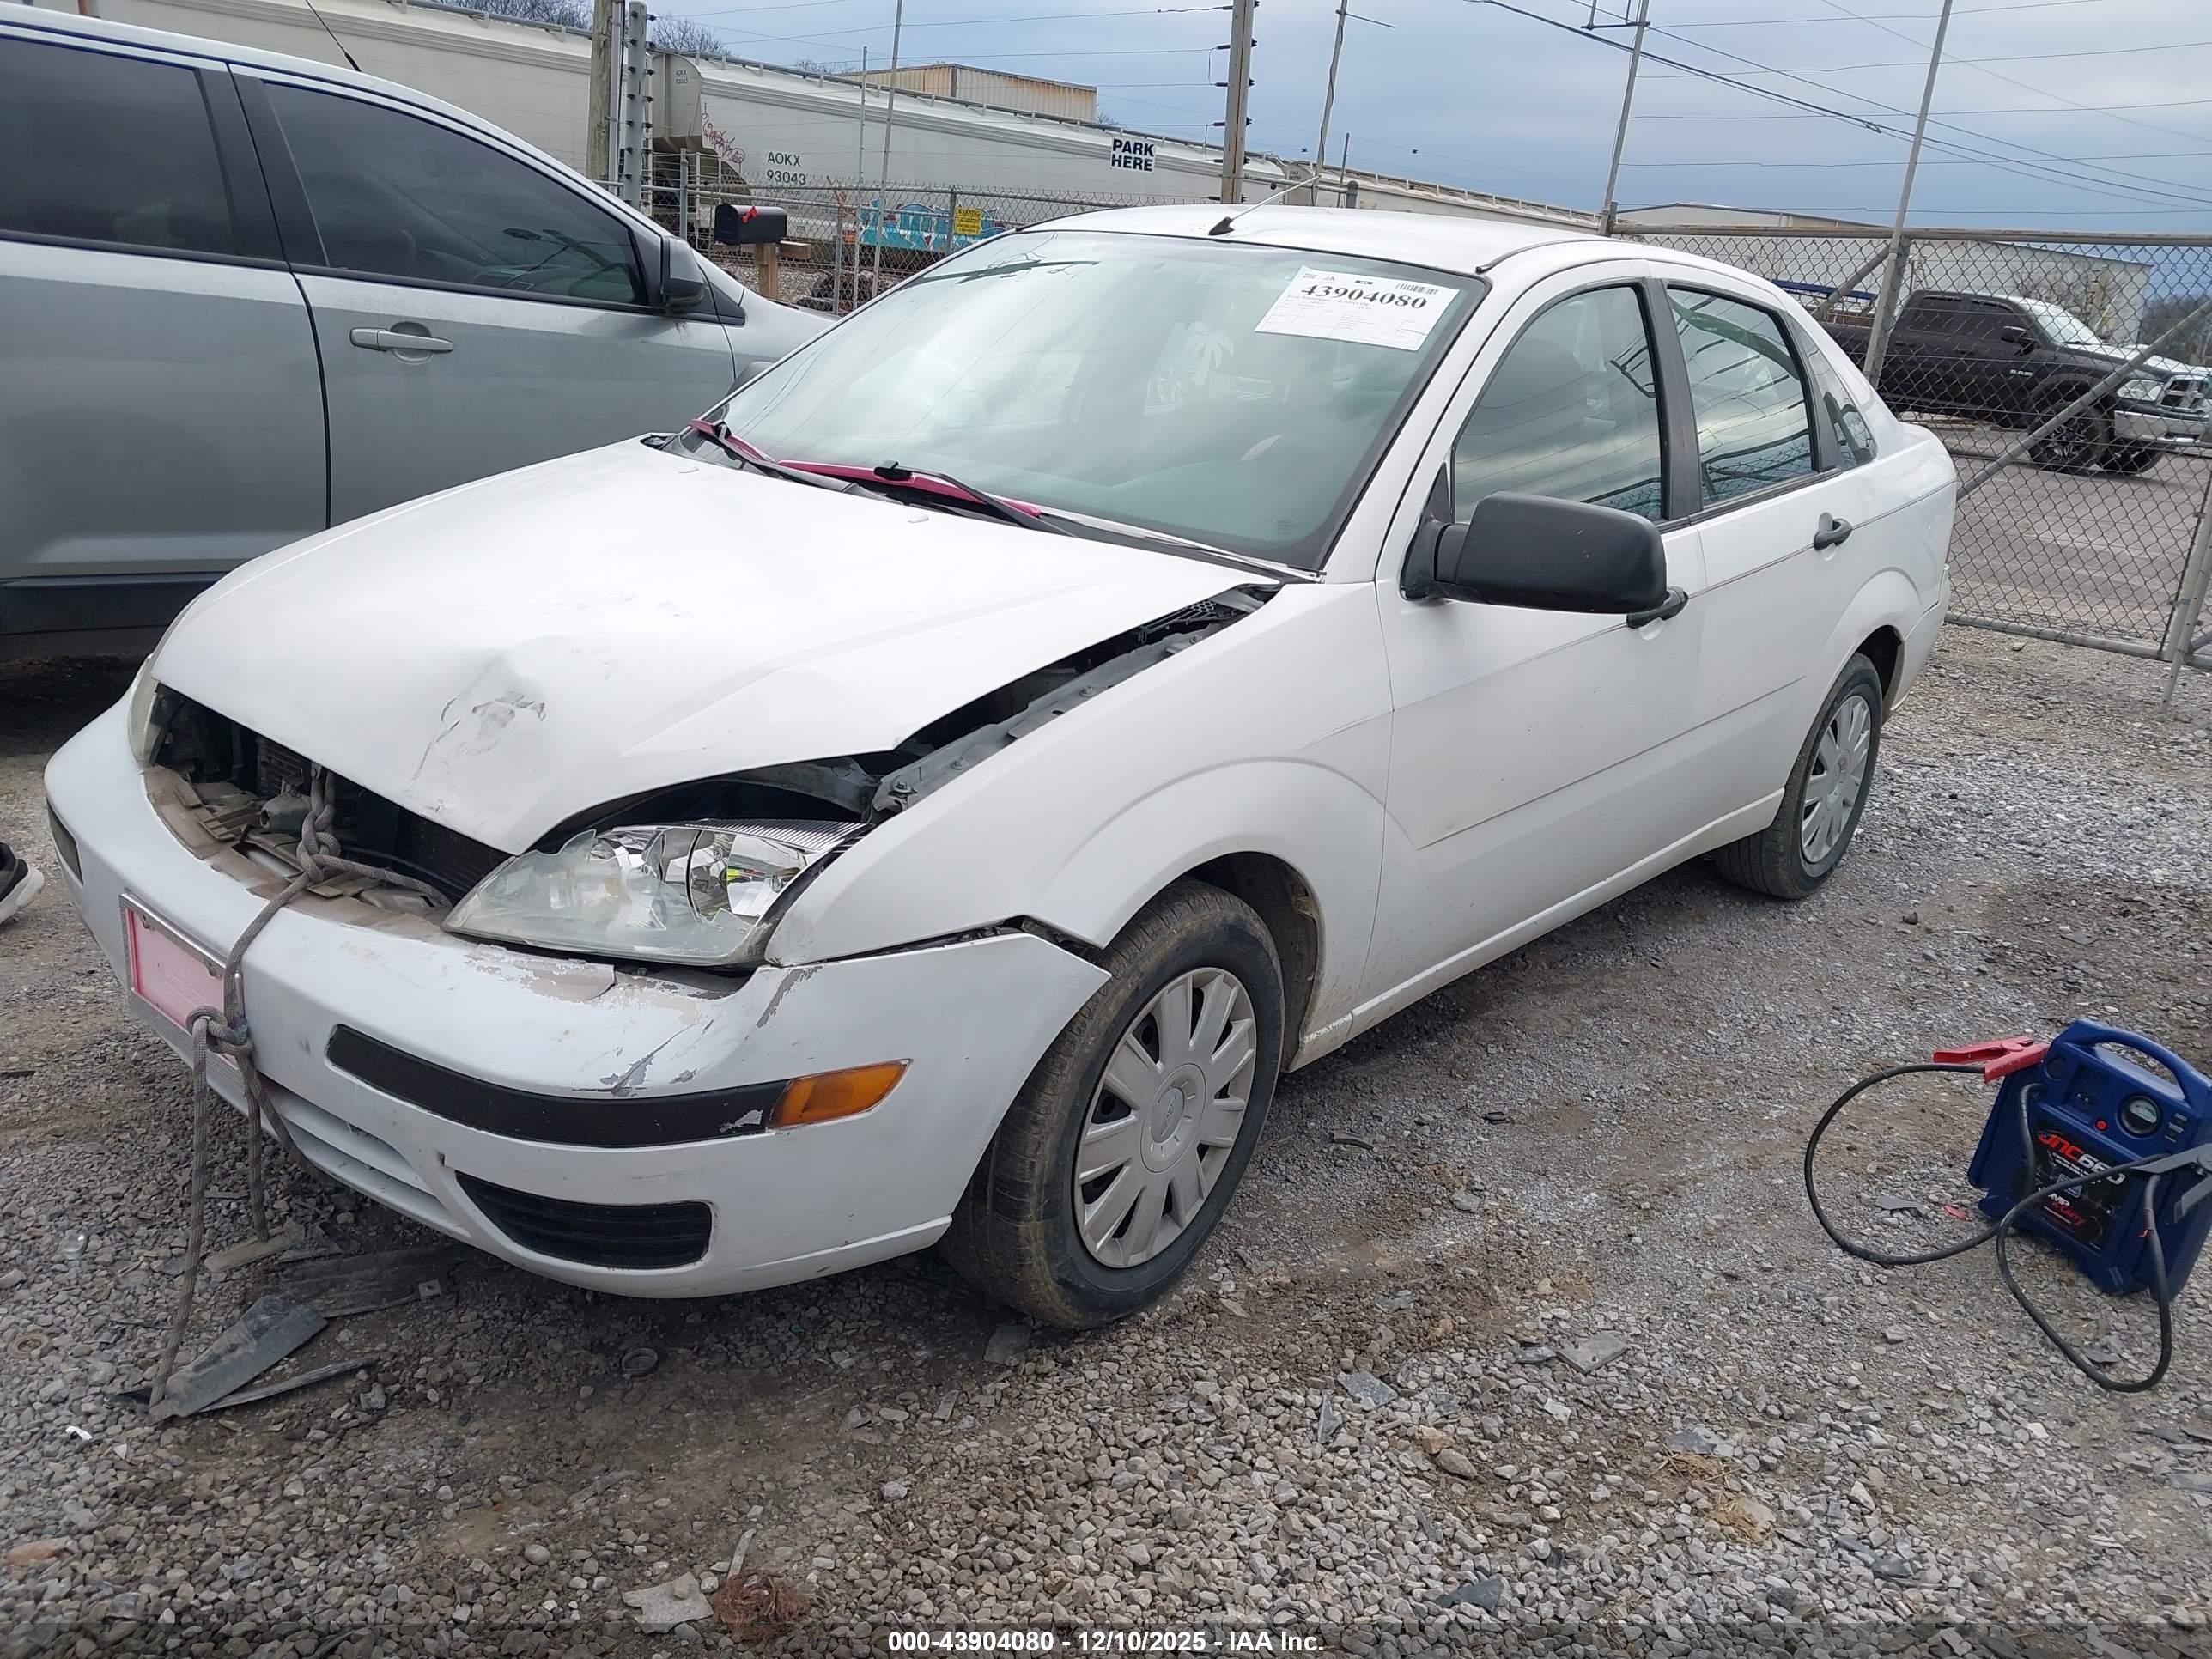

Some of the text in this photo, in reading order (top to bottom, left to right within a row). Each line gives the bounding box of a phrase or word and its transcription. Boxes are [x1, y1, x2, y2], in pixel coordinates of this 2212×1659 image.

[1113, 138, 1155, 157] PARK
[767, 151, 801, 167] AOKX
[1111, 154, 1153, 172] HERE
[766, 169, 807, 185] 93043
[1300, 284, 1427, 309] 43904080
